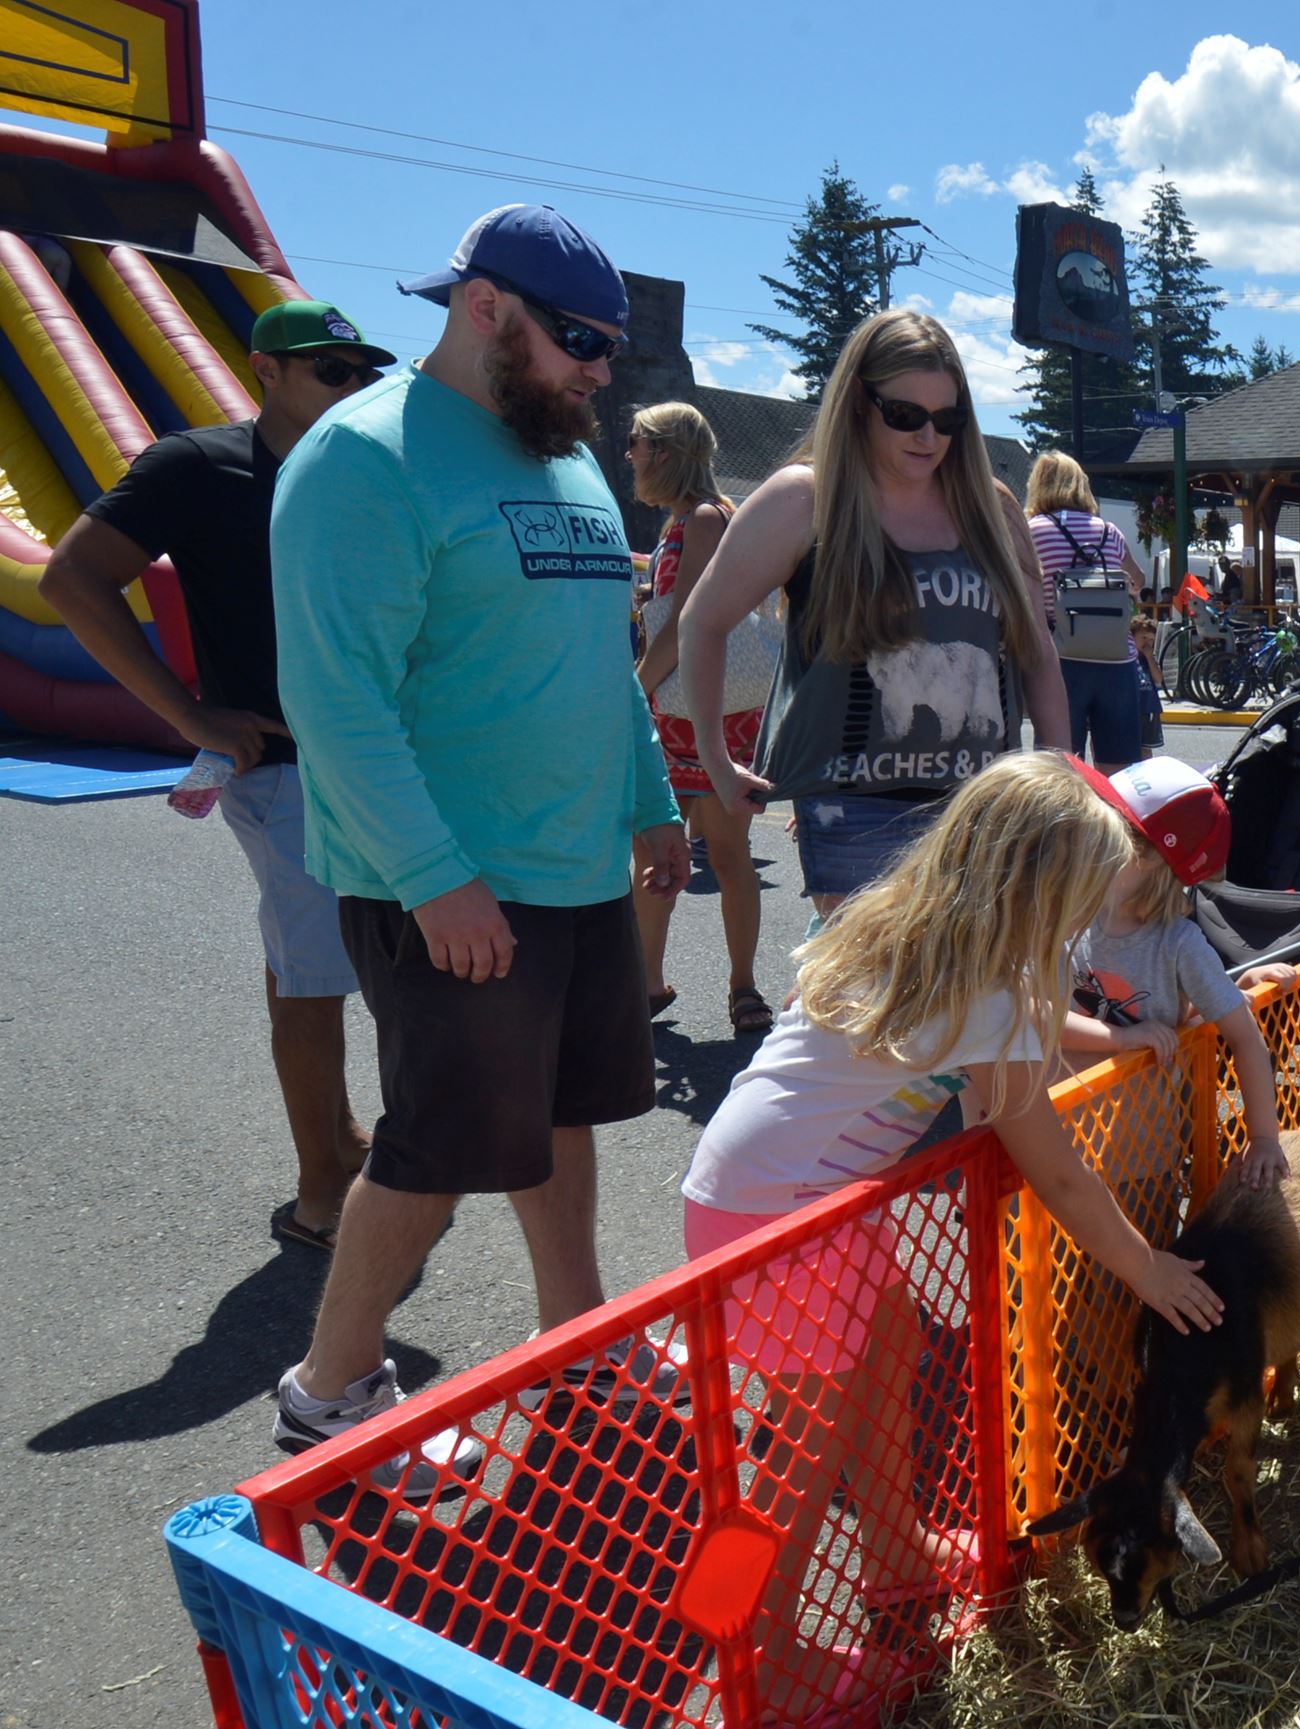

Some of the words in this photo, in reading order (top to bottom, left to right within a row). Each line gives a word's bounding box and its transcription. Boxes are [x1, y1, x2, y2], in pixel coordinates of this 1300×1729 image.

[569, 515, 623, 547] FISH
[527, 558, 571, 572] UNDER
[574, 560, 632, 575] ARMOUR
[953, 749, 976, 780] &
